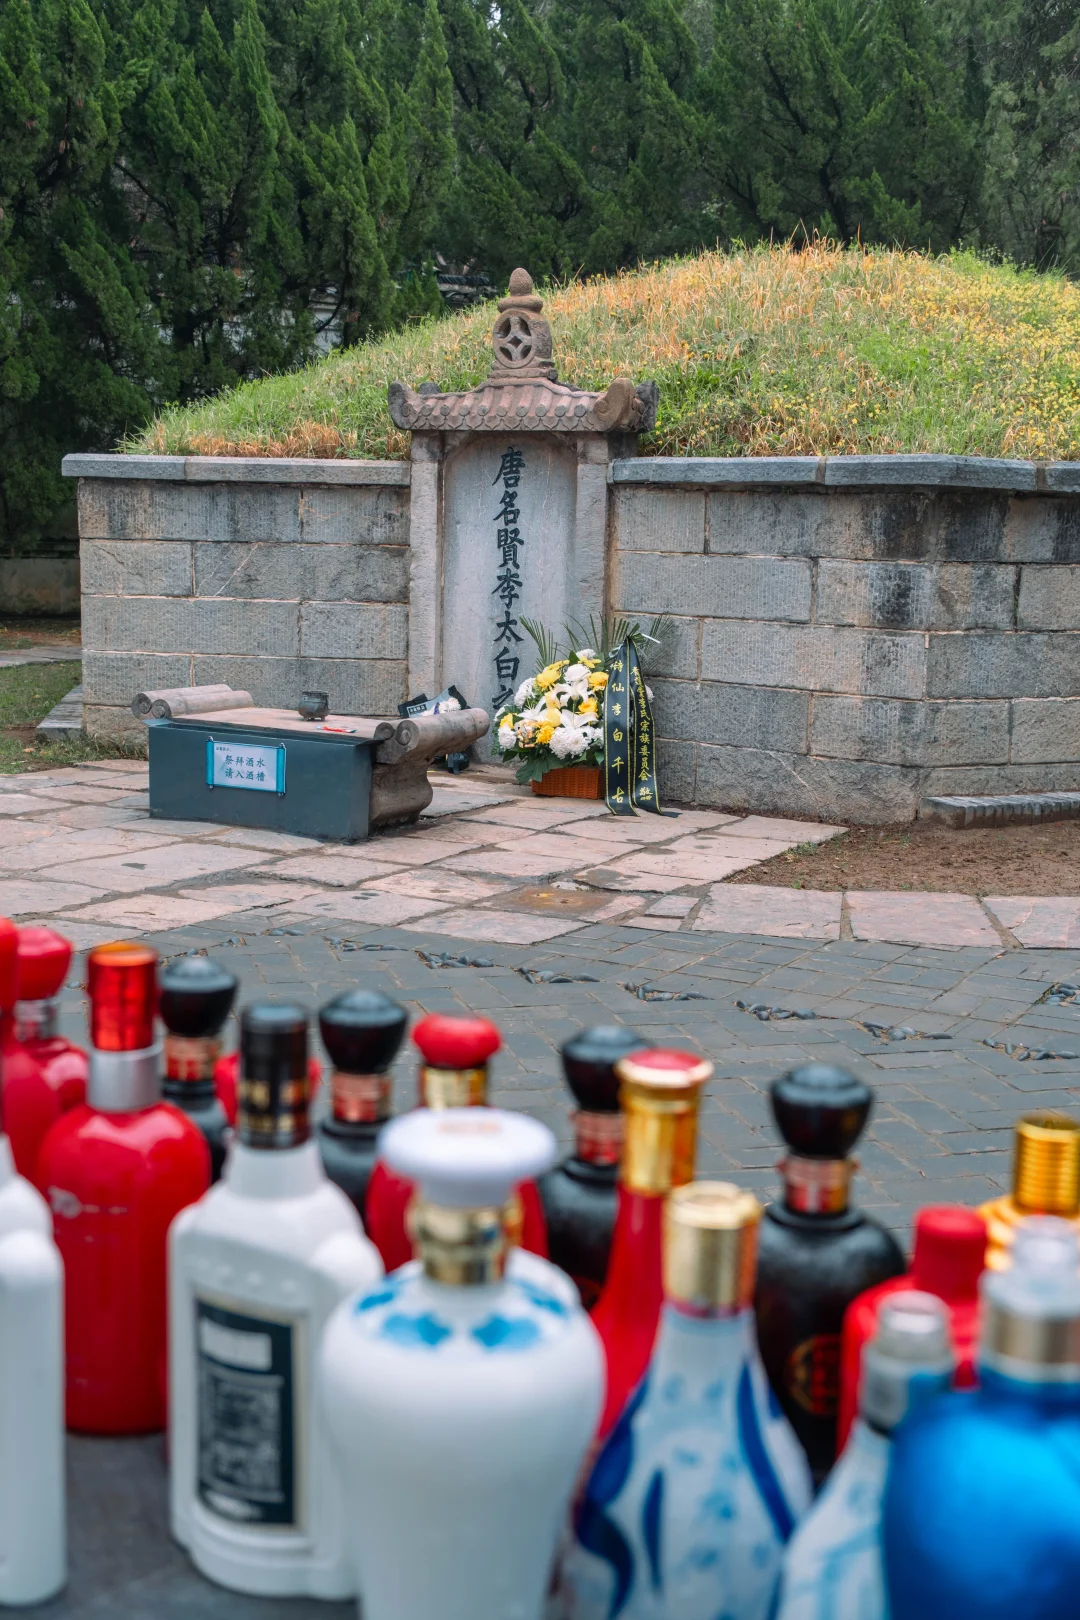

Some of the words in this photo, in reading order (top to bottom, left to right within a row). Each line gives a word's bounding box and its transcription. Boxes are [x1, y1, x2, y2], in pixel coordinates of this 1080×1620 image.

[225, 754, 265, 768] 祭拜酒水
[225, 768, 265, 781] 请入酒槽
